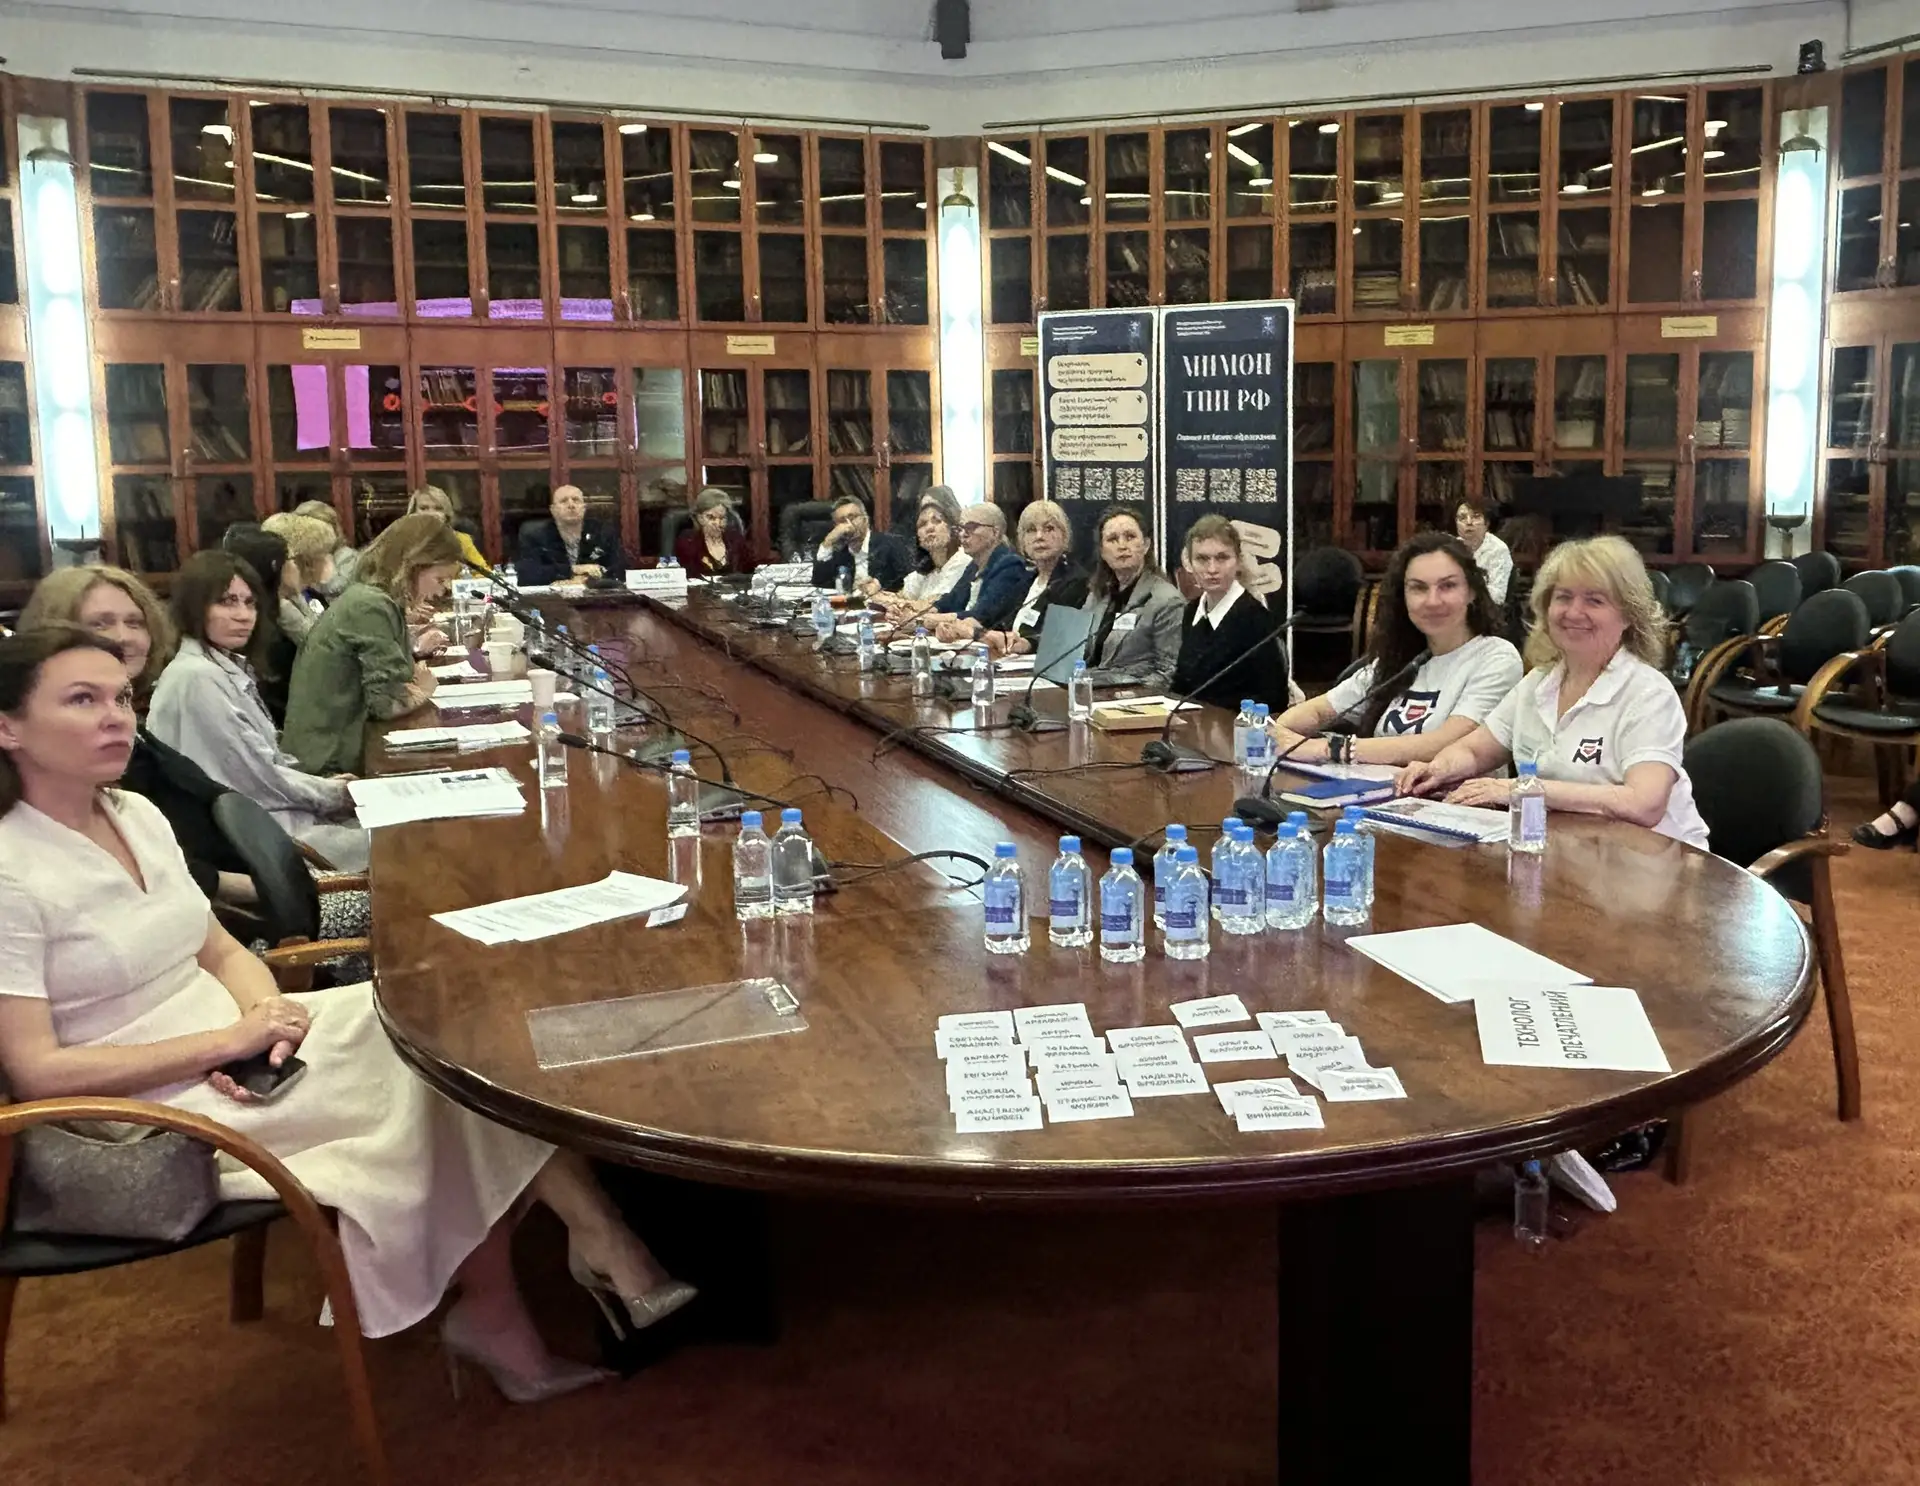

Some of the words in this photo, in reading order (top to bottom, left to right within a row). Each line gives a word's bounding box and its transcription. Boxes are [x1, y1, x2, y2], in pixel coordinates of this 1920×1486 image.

[1183, 388, 1230, 412] ТПП
[1236, 387, 1272, 412] РФ
[1508, 996, 1541, 1048] ТЕХНОЛОГ
[1541, 990, 1588, 1060] ВПЕЧАТЛЕНИЙ
